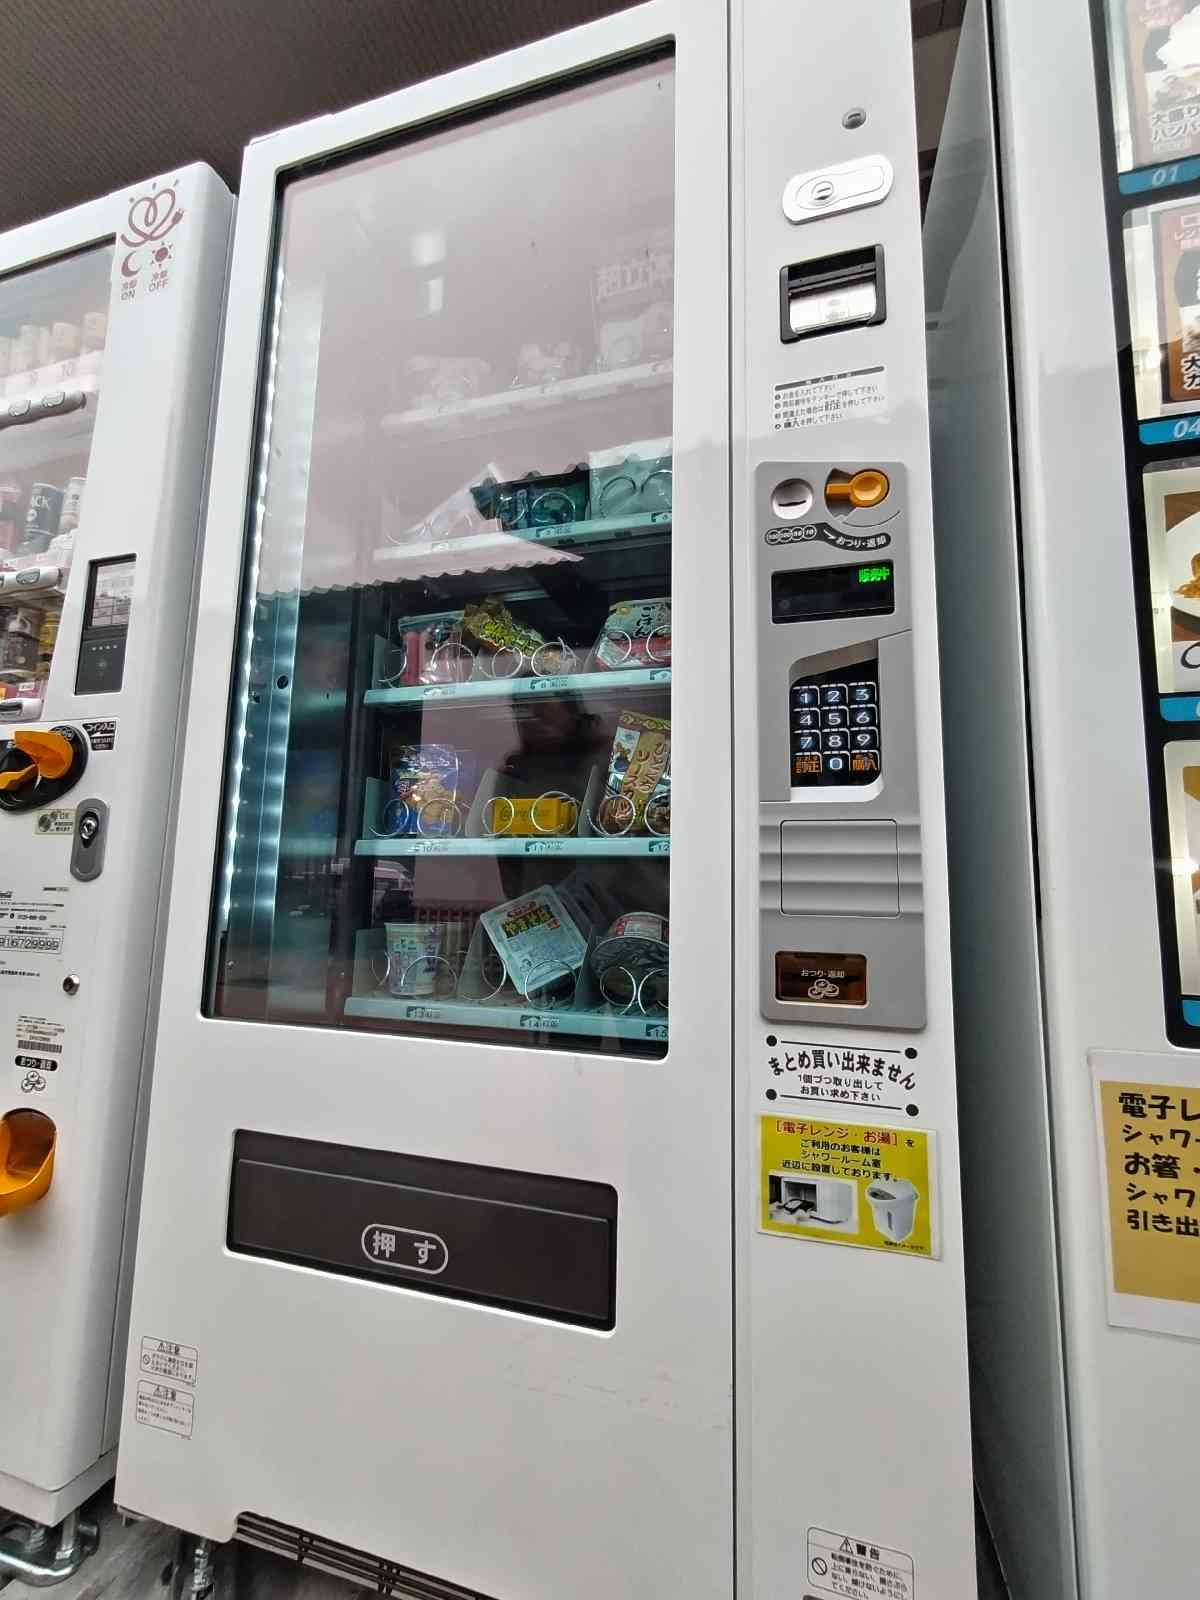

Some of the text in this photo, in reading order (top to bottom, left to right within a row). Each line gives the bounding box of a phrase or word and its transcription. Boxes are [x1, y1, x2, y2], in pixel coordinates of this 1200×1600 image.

[1152, 165, 1179, 185] 01
[148, 279, 169, 292] OFF
[121, 289, 136, 301] ON
[800, 692, 809, 704] 1
[827, 690, 840, 702] 2
[855, 688, 869, 701] 3
[799, 714, 812, 726] 4
[828, 713, 841, 725] 5
[856, 711, 870, 724] 6
[800, 736, 812, 749] 7
[828, 735, 842, 747] 8
[857, 733, 871, 746] 9
[829, 757, 843, 770] 0
[768, 1050, 916, 1091] まとめ買い出来ません
[798, 1074, 884, 1091] 1個づつ取り出して
[800, 1086, 881, 1102] お買い求め下さい
[1122, 1124, 1200, 1149] シャワ
[801, 1139, 881, 1156] ご利用のお客様は
